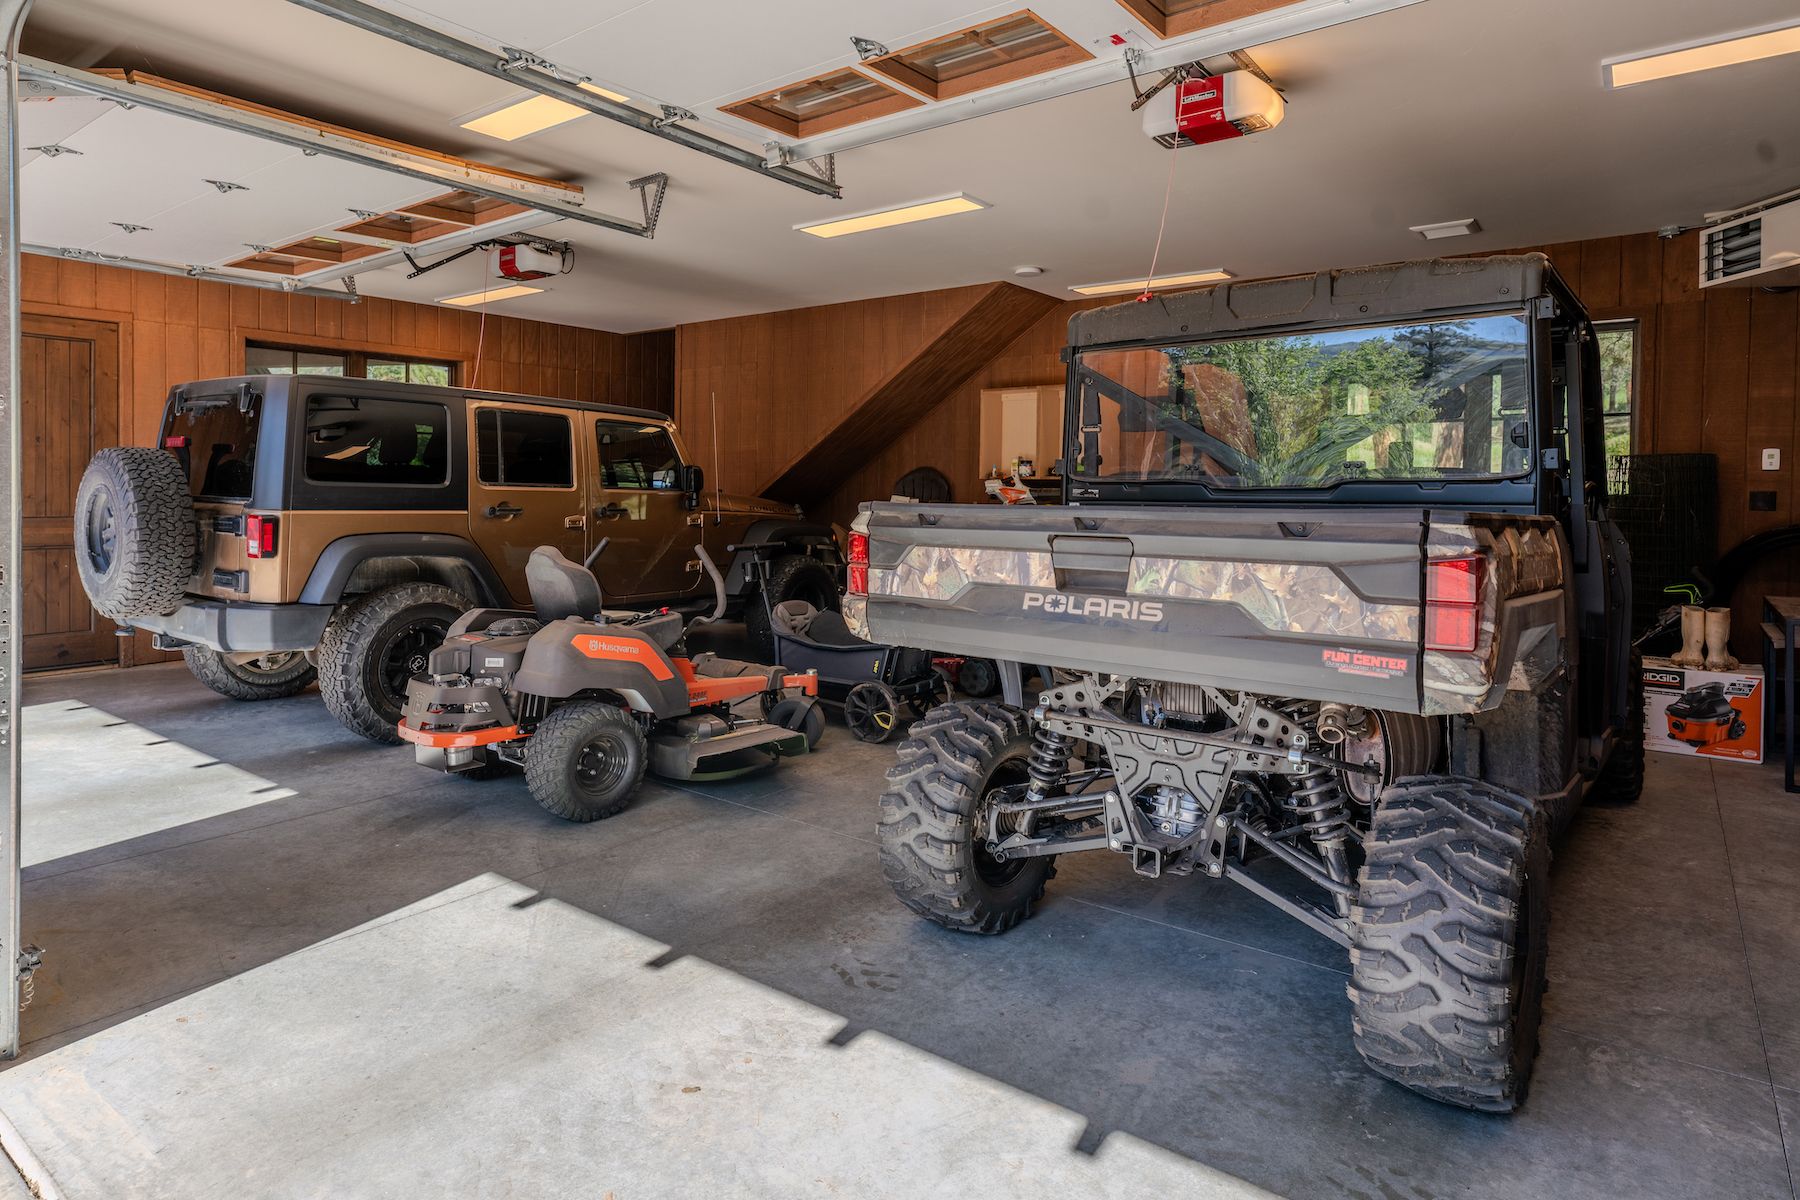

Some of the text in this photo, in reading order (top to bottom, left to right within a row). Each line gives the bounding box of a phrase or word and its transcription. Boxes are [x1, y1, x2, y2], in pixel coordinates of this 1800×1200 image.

[1022, 592, 1164, 622] POLARIS
[599, 641, 639, 654] Husqvarna
[1323, 650, 1350, 663] FUN
[1353, 653, 1408, 671] CENTER
